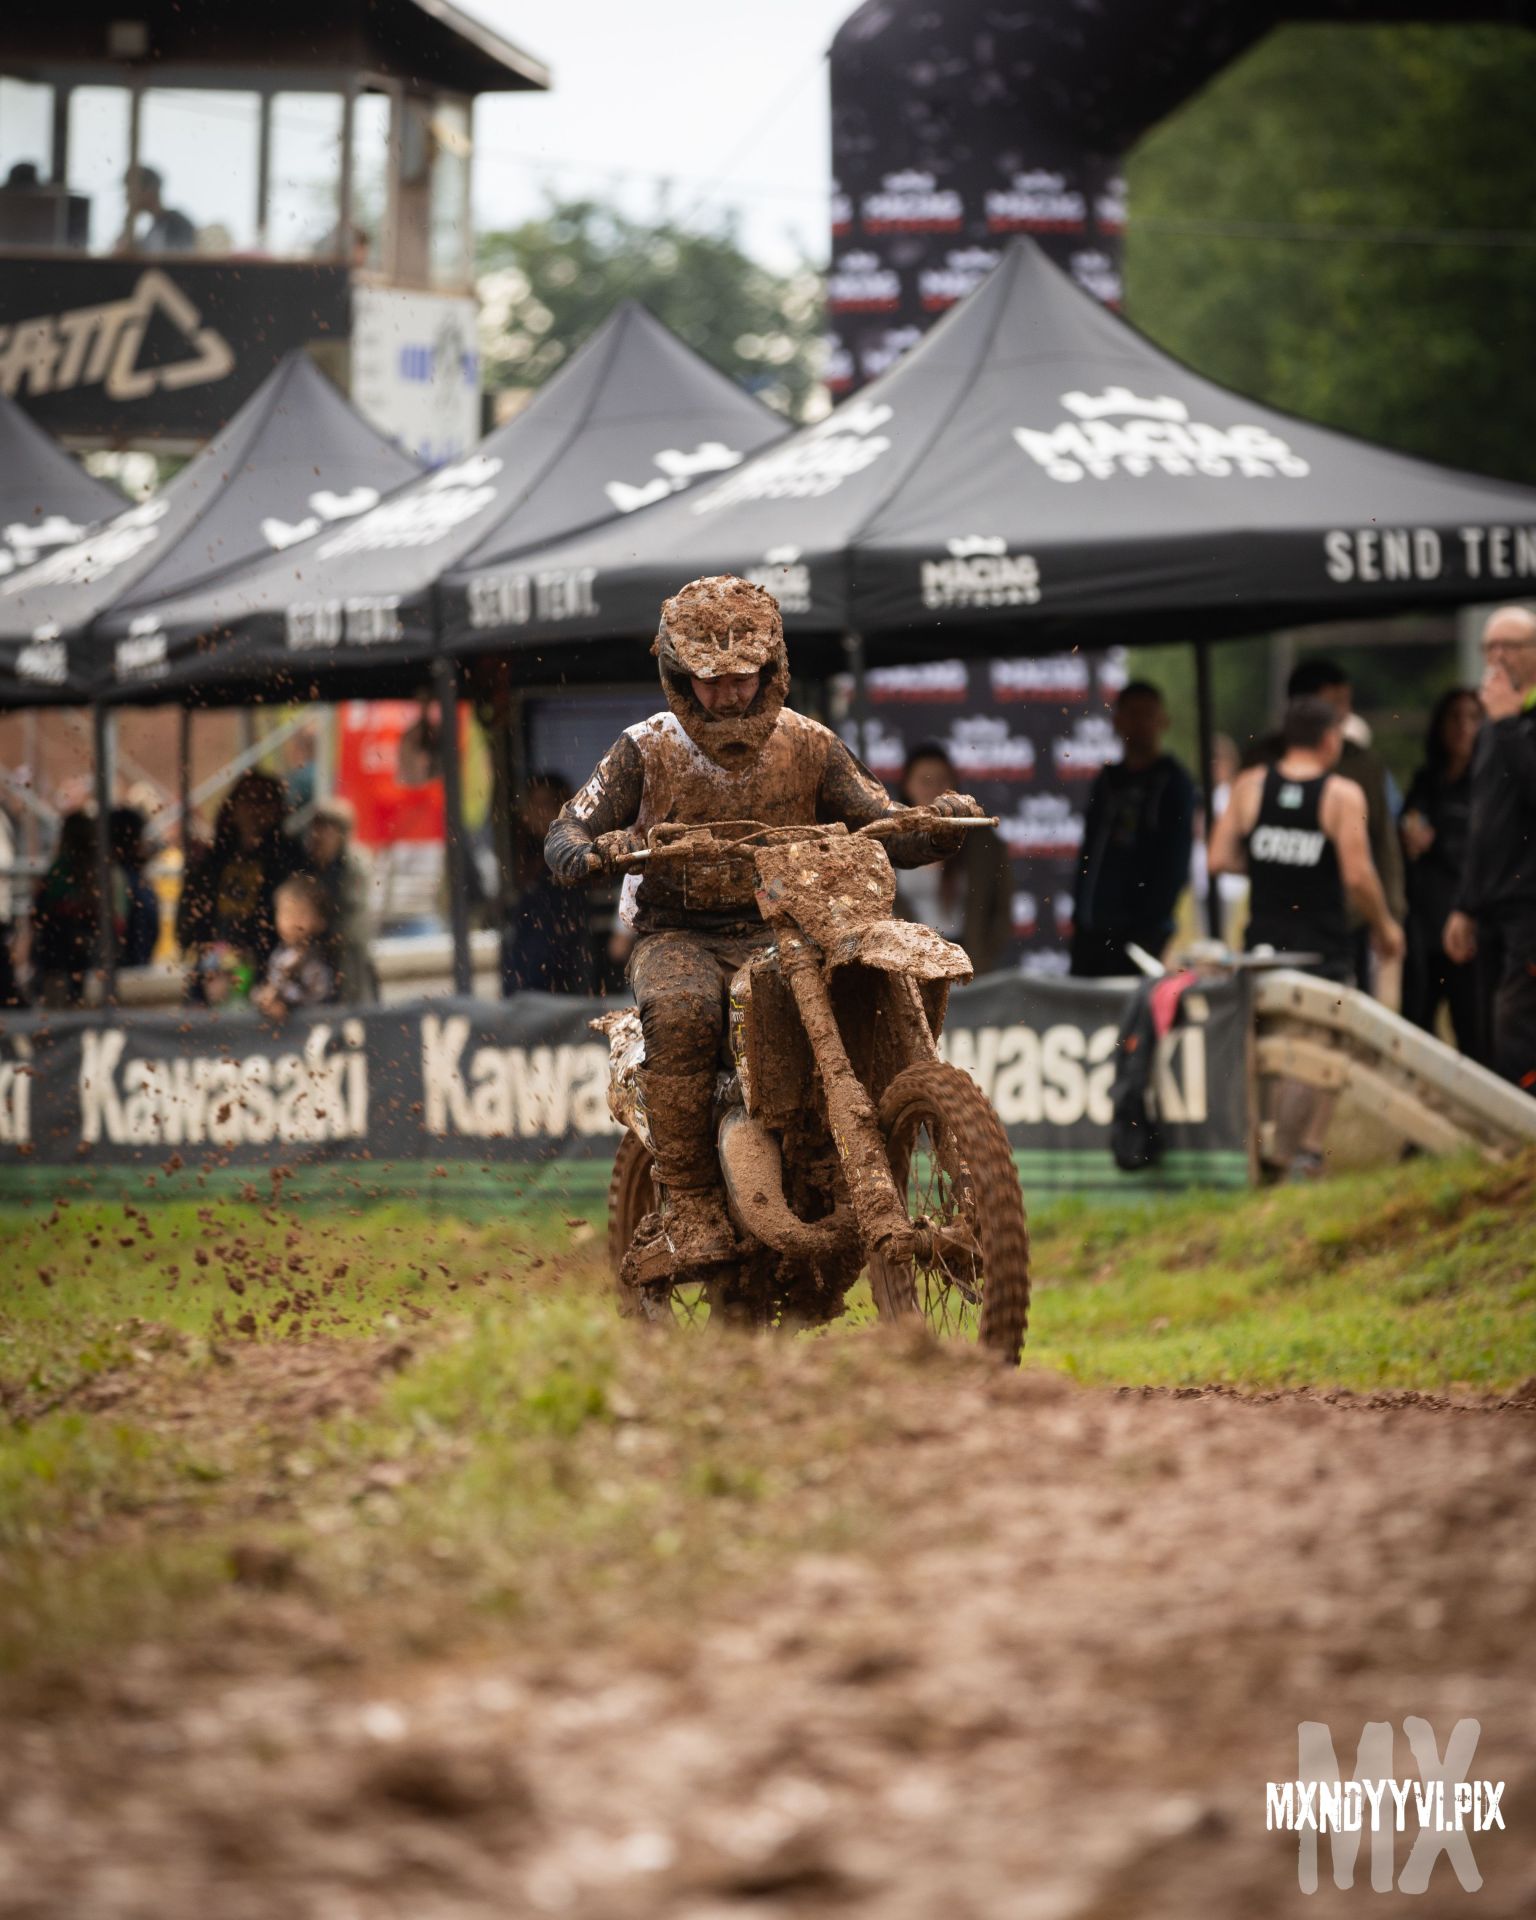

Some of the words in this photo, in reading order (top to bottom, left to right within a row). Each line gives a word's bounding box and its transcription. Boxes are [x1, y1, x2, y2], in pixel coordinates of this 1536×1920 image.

[1324, 528, 1439, 583] SEND
[1251, 824, 1327, 867] CREW
[81, 1018, 369, 1146] Kawasaki
